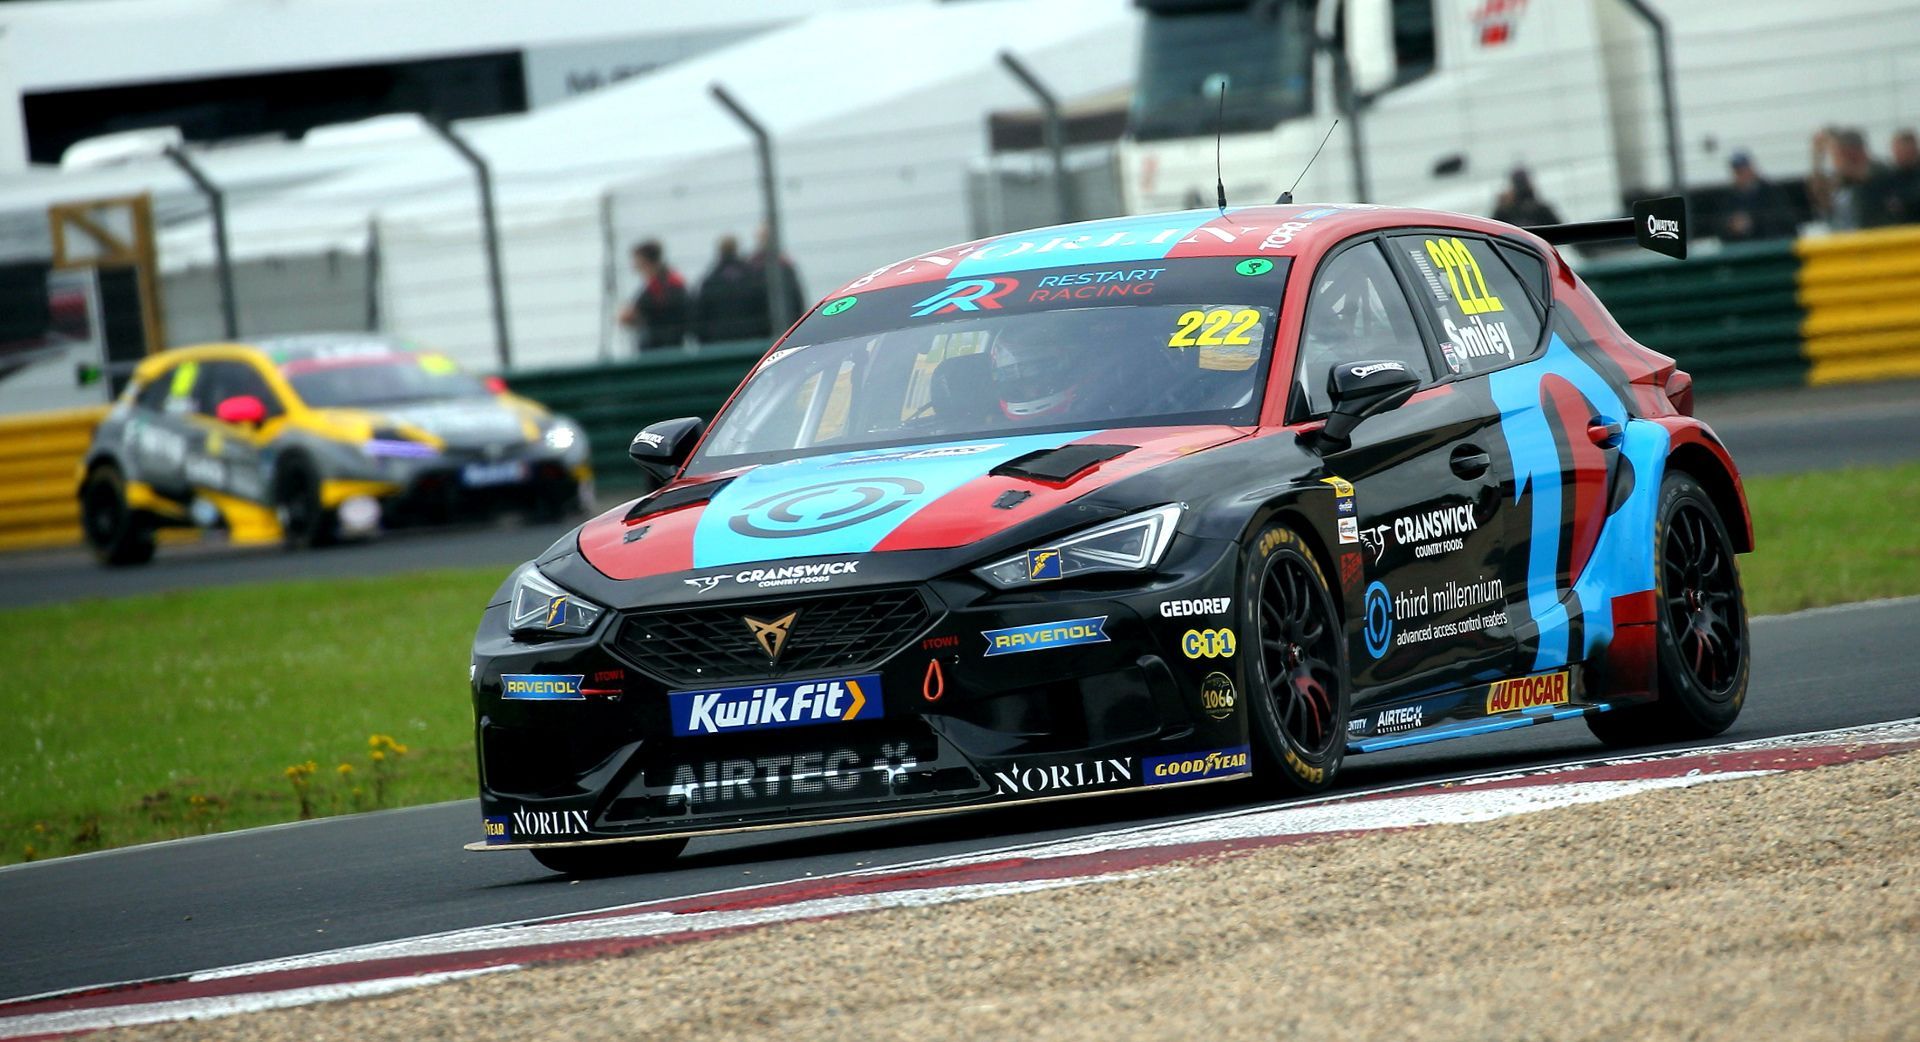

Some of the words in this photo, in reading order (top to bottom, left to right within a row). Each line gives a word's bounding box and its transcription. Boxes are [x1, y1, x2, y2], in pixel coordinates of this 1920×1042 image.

[1038, 268, 1166, 288] RESTART
[1425, 237, 1505, 315] 222
[1028, 282, 1155, 302] RACING
[1168, 309, 1262, 348] 222
[1443, 315, 1515, 360] Smiley
[1394, 504, 1478, 545] CRANSWICK
[1415, 542, 1442, 558] COUNTRY
[1443, 538, 1463, 552] FOODS
[736, 561, 859, 583] CRANSWICK
[758, 578, 798, 588] COUNTRY
[800, 576, 830, 584] FOODS
[1160, 598, 1223, 618] GEDORE
[1395, 586, 1428, 620] third
[1432, 575, 1503, 613] millennium
[995, 625, 1097, 649] RAVENOL
[1397, 624, 1432, 646] advanced
[1433, 622, 1458, 639] access
[1458, 614, 1482, 633] control
[1482, 611, 1508, 629] readers
[508, 682, 576, 693] RAVENOL
[1203, 689, 1234, 708] 1066
[1491, 674, 1564, 713] AUTOCAR
[1377, 706, 1414, 727] AIRTEC
[666, 748, 861, 806] AIRTEC
[995, 757, 1132, 796] NORLIN
[513, 805, 589, 835] NORLIN
